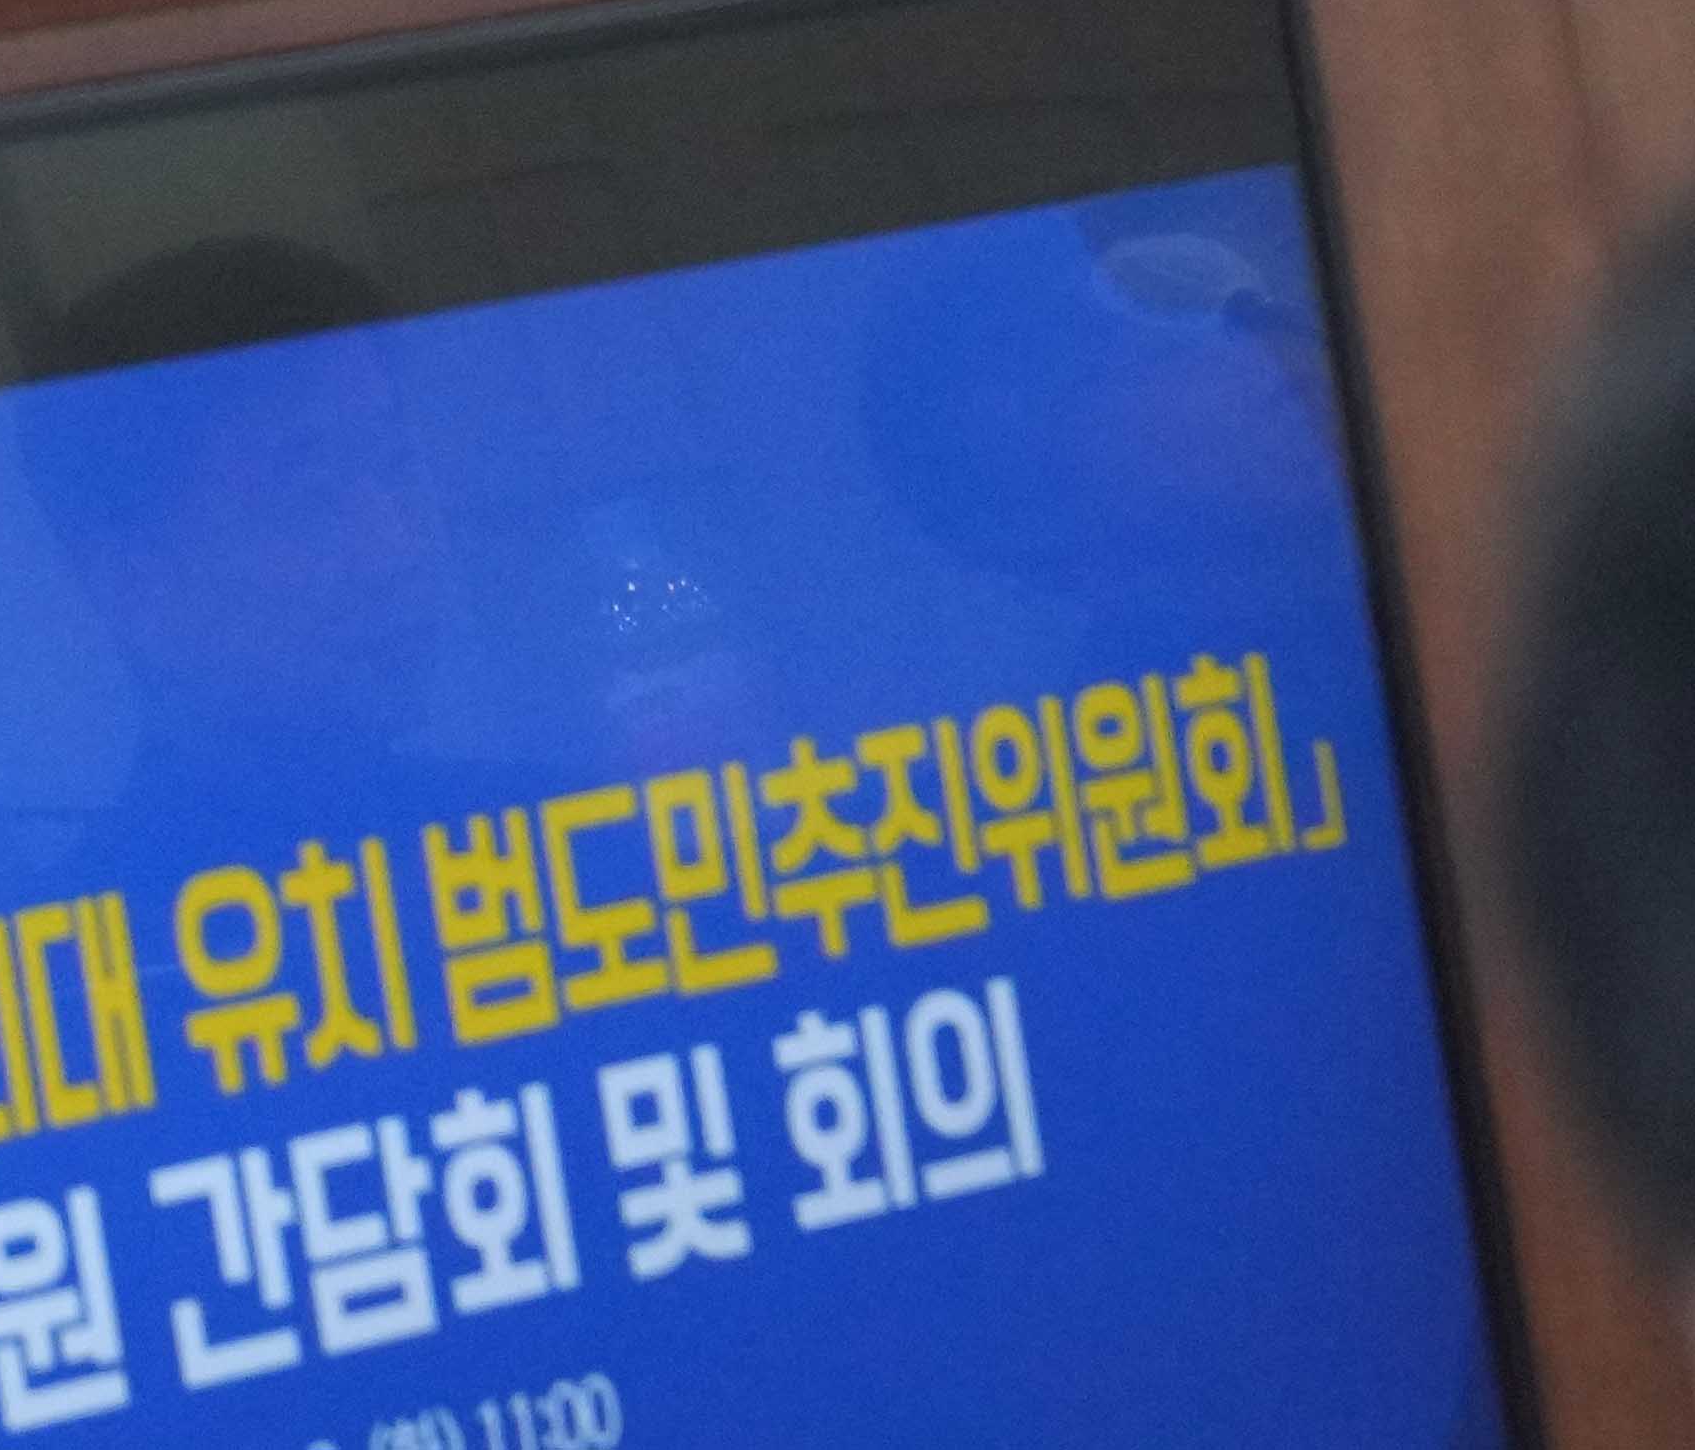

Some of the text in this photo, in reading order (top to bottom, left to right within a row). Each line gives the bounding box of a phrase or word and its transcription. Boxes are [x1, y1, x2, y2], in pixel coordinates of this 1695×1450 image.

[176, 838, 415, 1091] 유치
[149, 1083, 579, 1389] 간담회
[598, 1045, 751, 1278] 및
[773, 978, 1042, 1230] 회의
